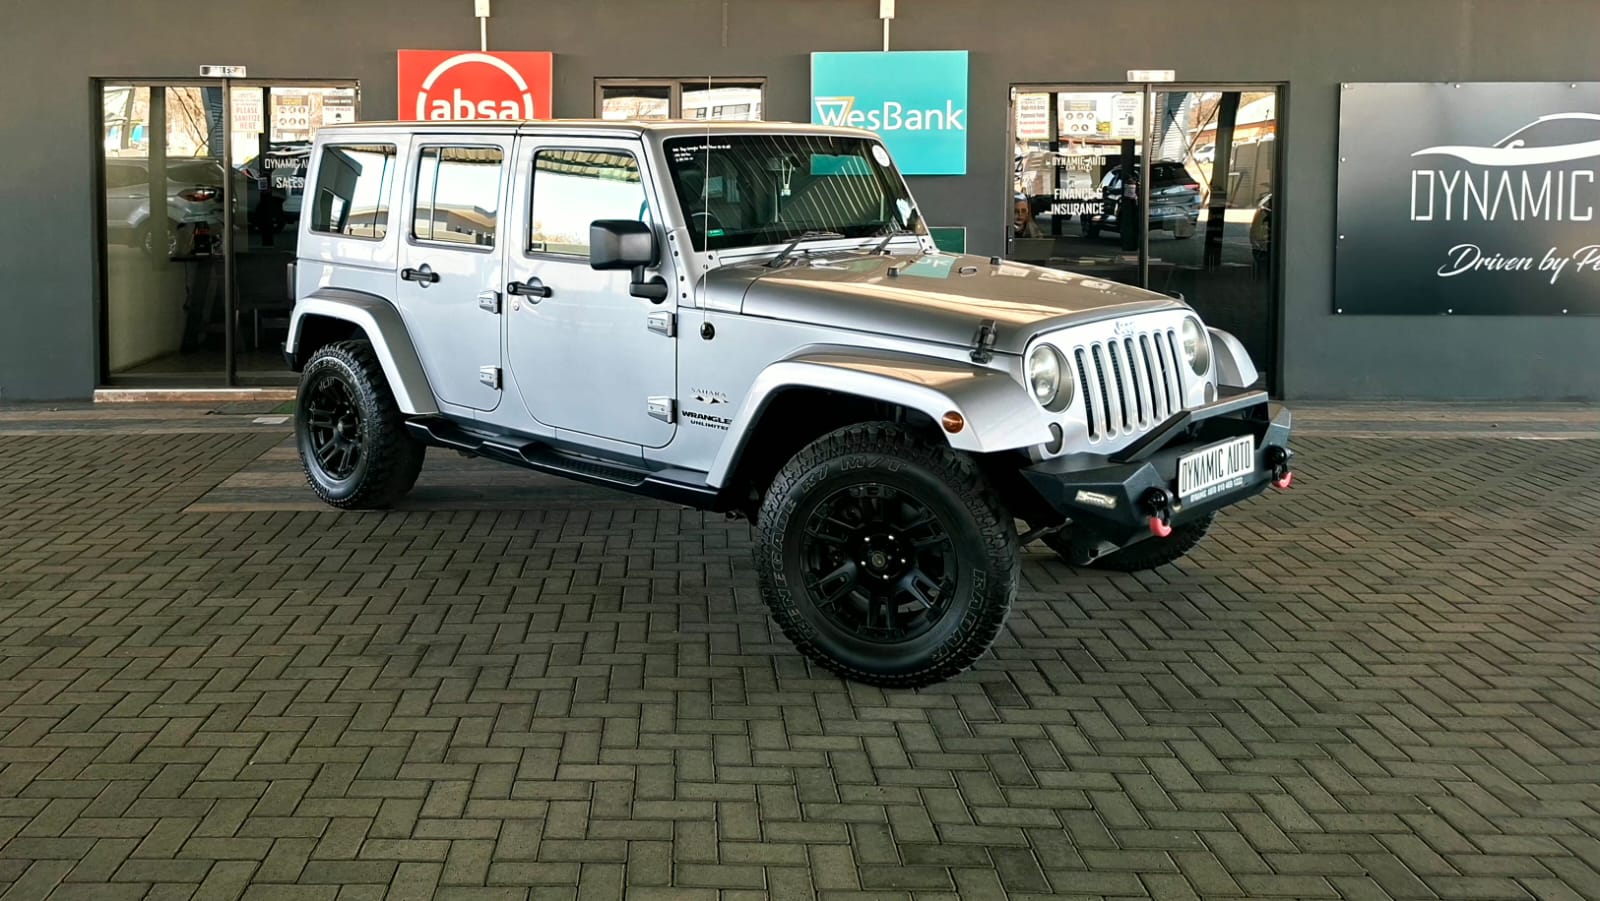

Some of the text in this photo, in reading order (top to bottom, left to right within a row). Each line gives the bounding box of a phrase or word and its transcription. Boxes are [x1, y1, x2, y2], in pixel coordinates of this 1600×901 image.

[430, 88, 520, 120] absa
[814, 96, 965, 131] WesBank
[264, 158, 299, 169] DYNAMIC
[276, 177, 304, 188] SALES
[1054, 188, 1094, 200] FINANCE
[1410, 170, 1594, 221] DYNAMIC
[1051, 203, 1105, 215] INSURANCE
[1437, 243, 1534, 277] Driven
[1538, 247, 1570, 285] by
[682, 410, 733, 425] WRANGLE
[1182, 448, 1224, 493] DYNAMIC
[1227, 440, 1251, 476] AUTO
